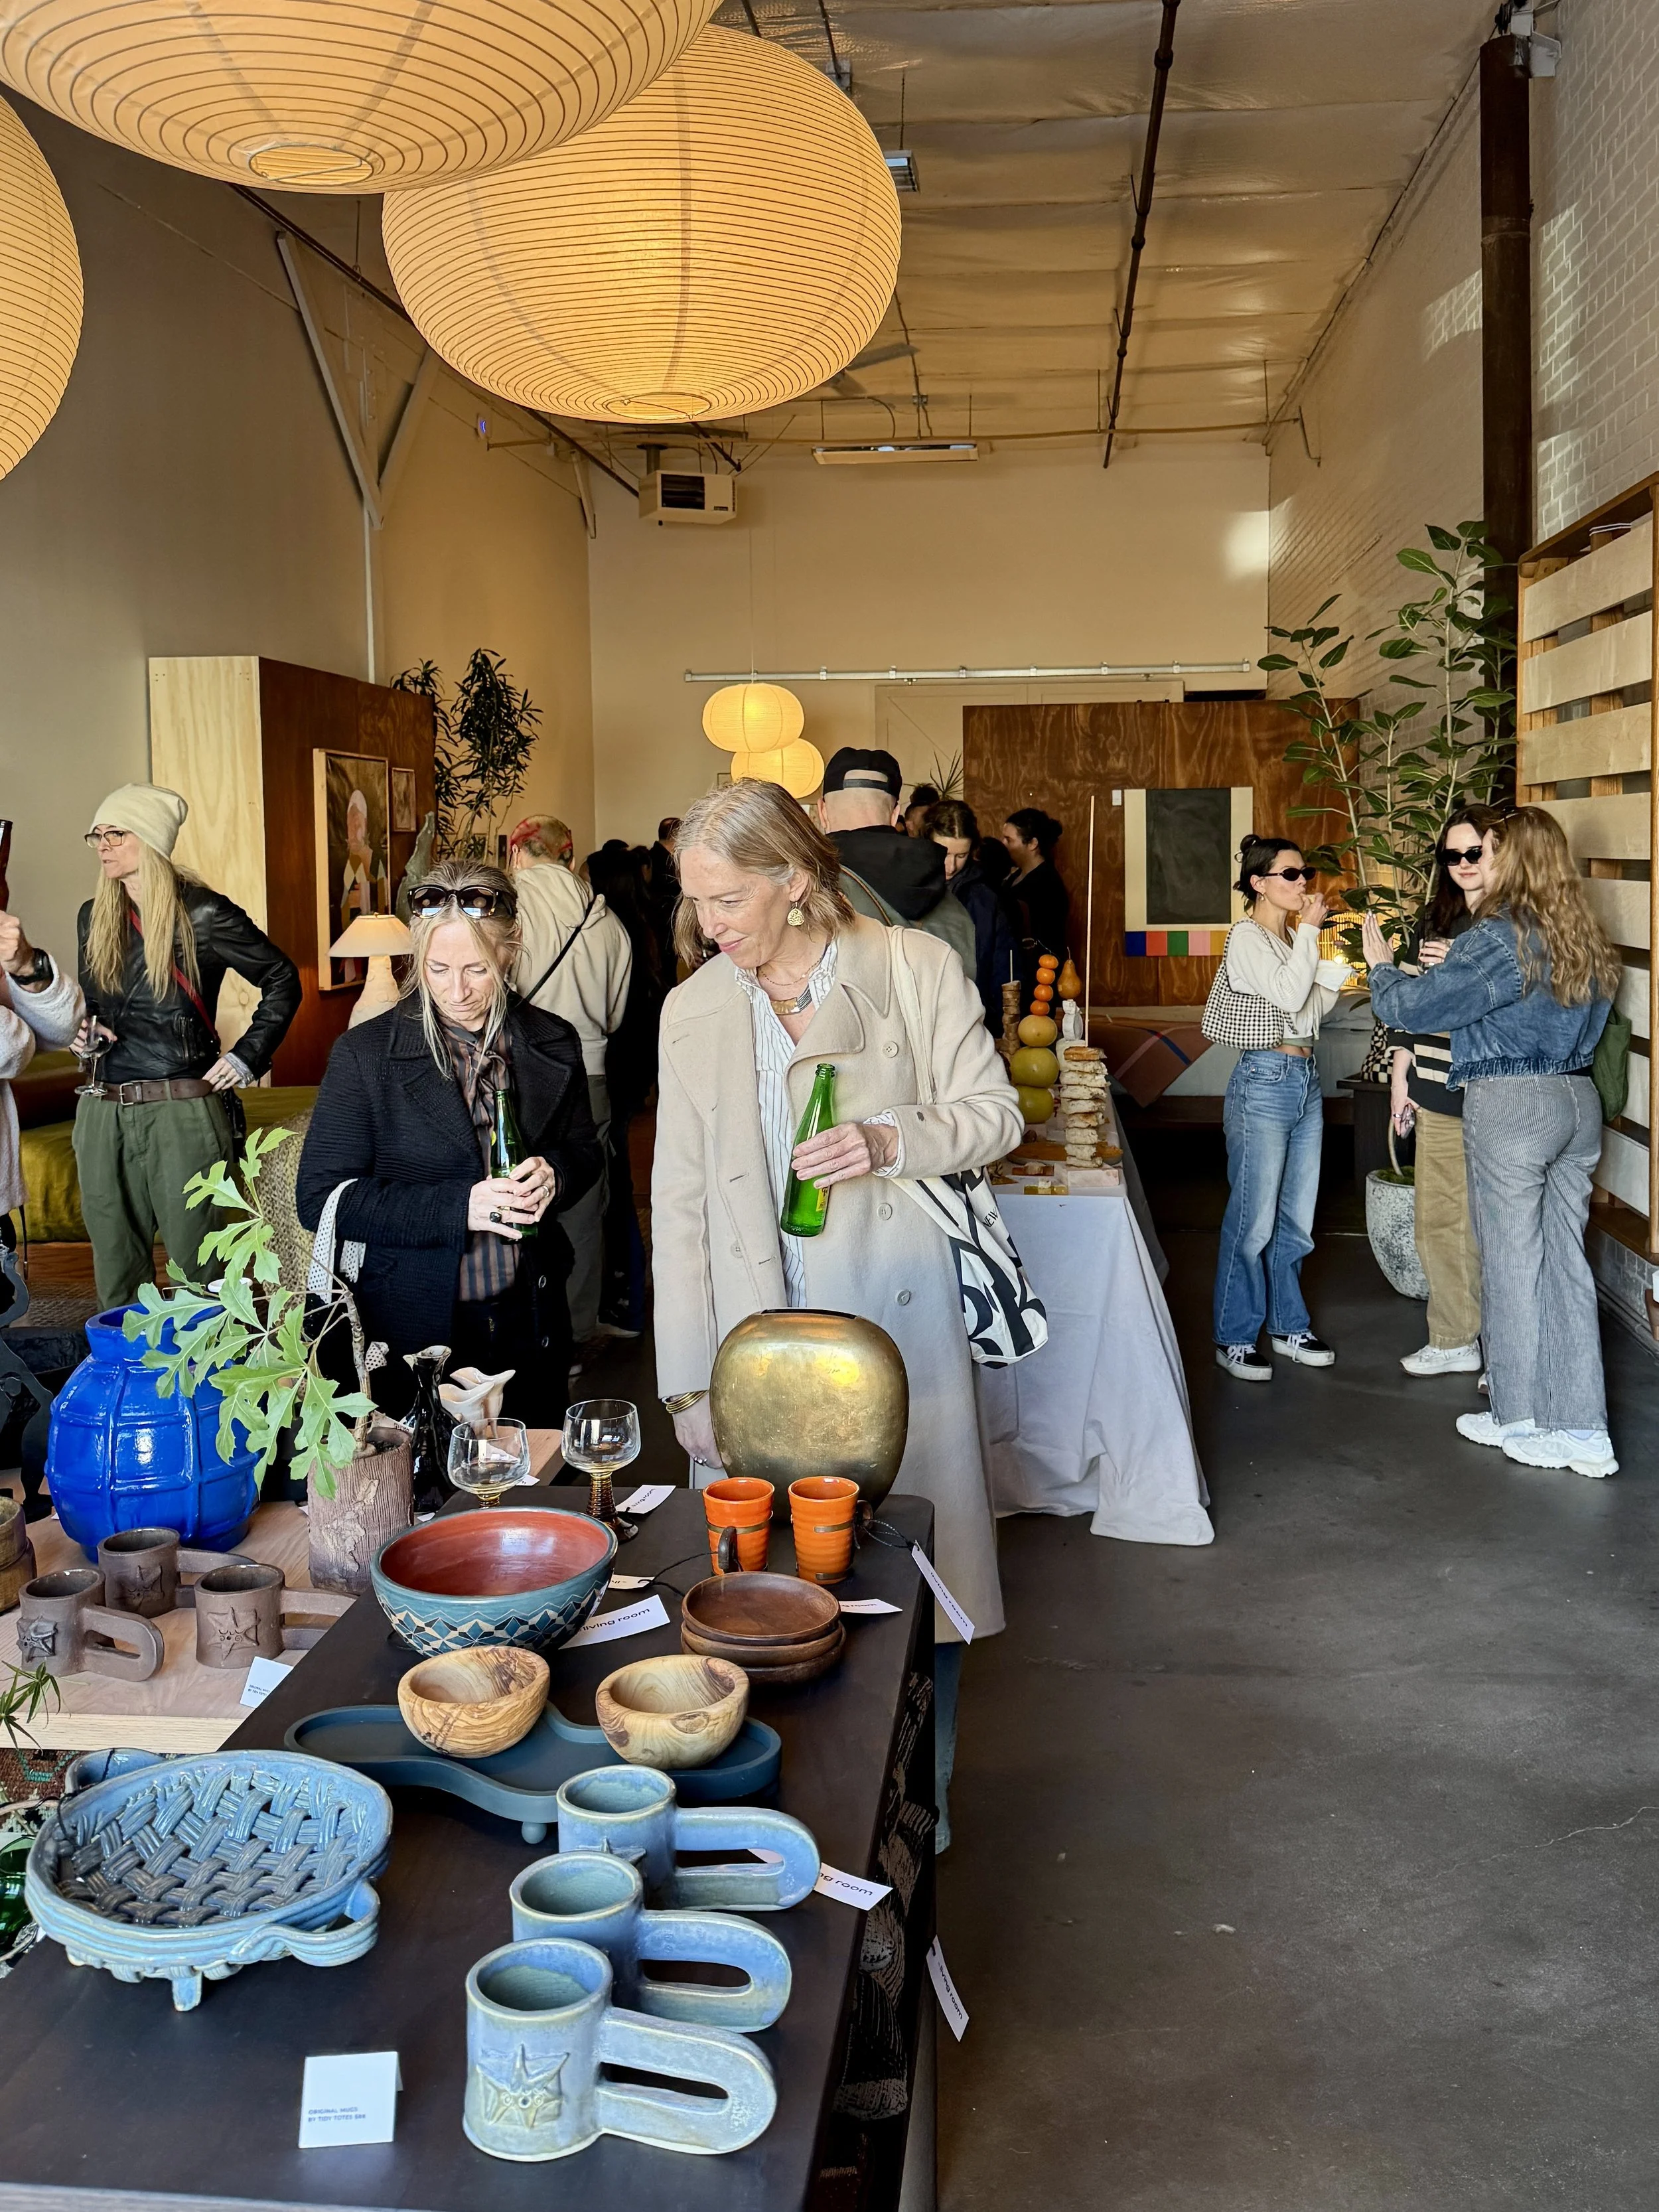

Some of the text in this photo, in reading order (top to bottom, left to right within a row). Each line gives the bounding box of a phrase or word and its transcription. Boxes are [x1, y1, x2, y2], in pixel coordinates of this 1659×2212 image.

[583, 1608, 650, 1631] living room
[835, 1880, 873, 1896] room
[949, 1992, 962, 2020] room
